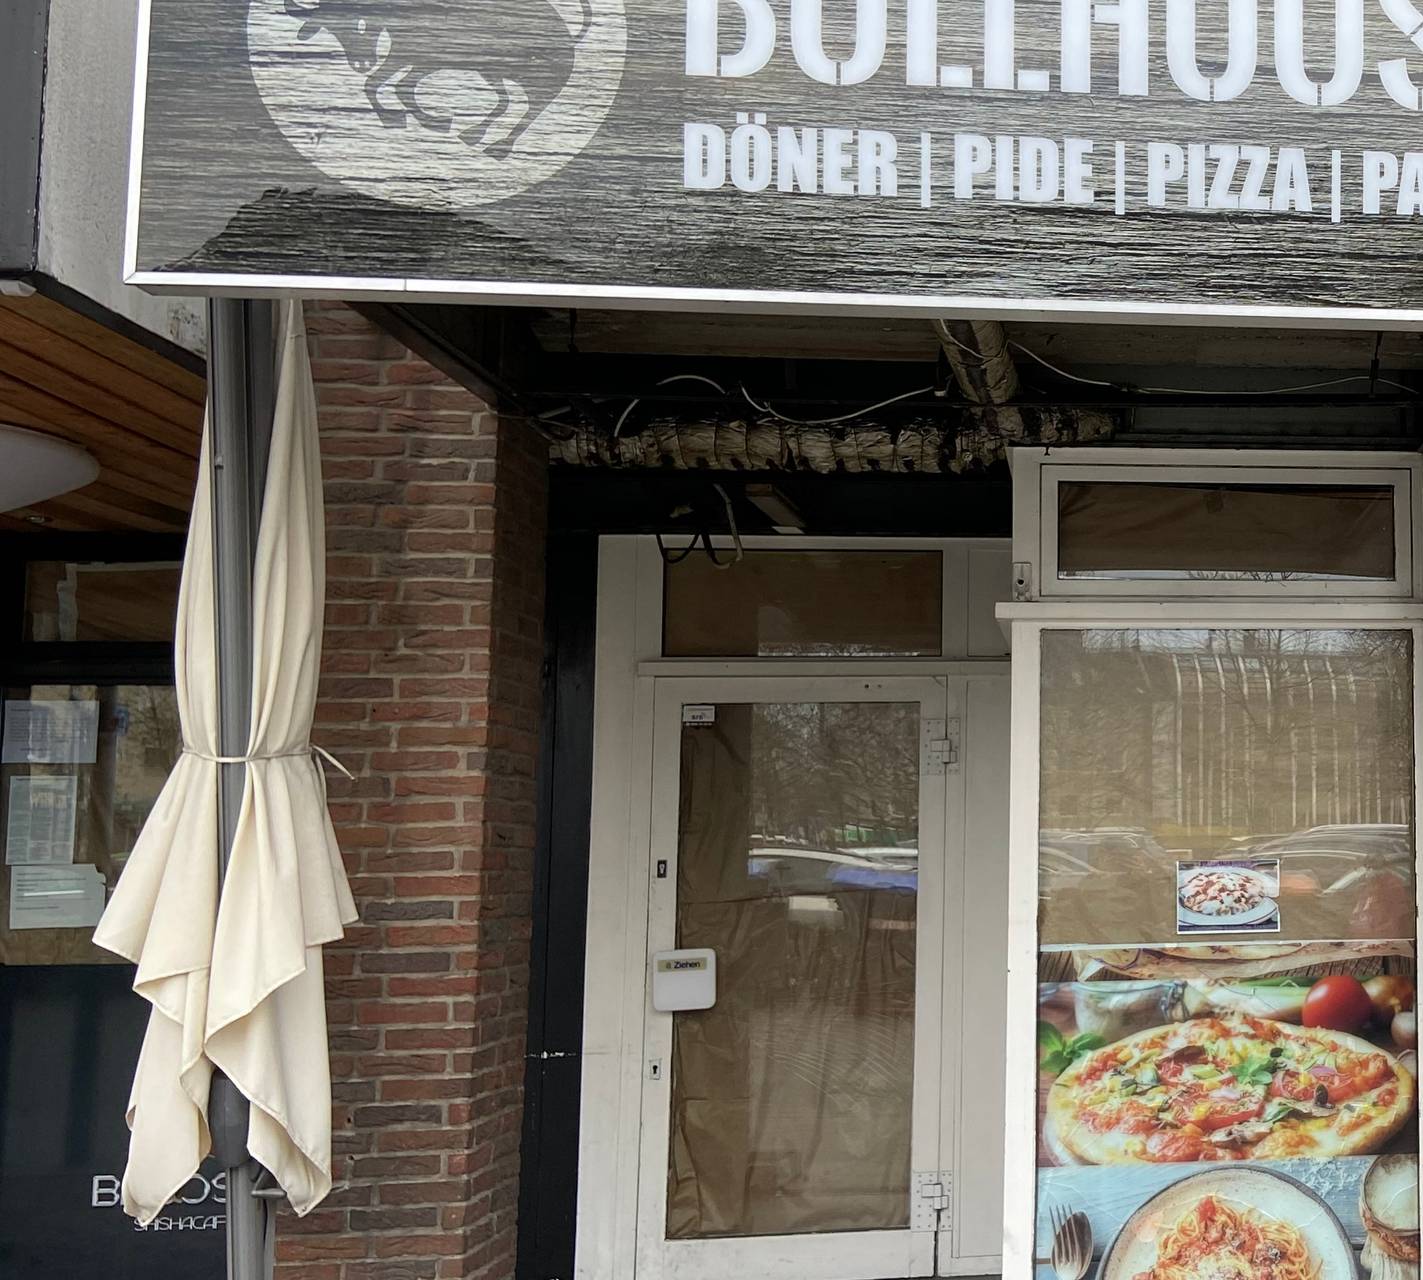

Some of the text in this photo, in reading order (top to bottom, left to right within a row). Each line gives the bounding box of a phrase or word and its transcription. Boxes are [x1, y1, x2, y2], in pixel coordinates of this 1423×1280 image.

[684, 111, 898, 198] DÖNER
[954, 133, 1095, 205] PIDE
[1147, 142, 1313, 212] PIZZA
[673, 960, 701, 969] Ziehen
[133, 1215, 227, 1232] SHISHACAF
